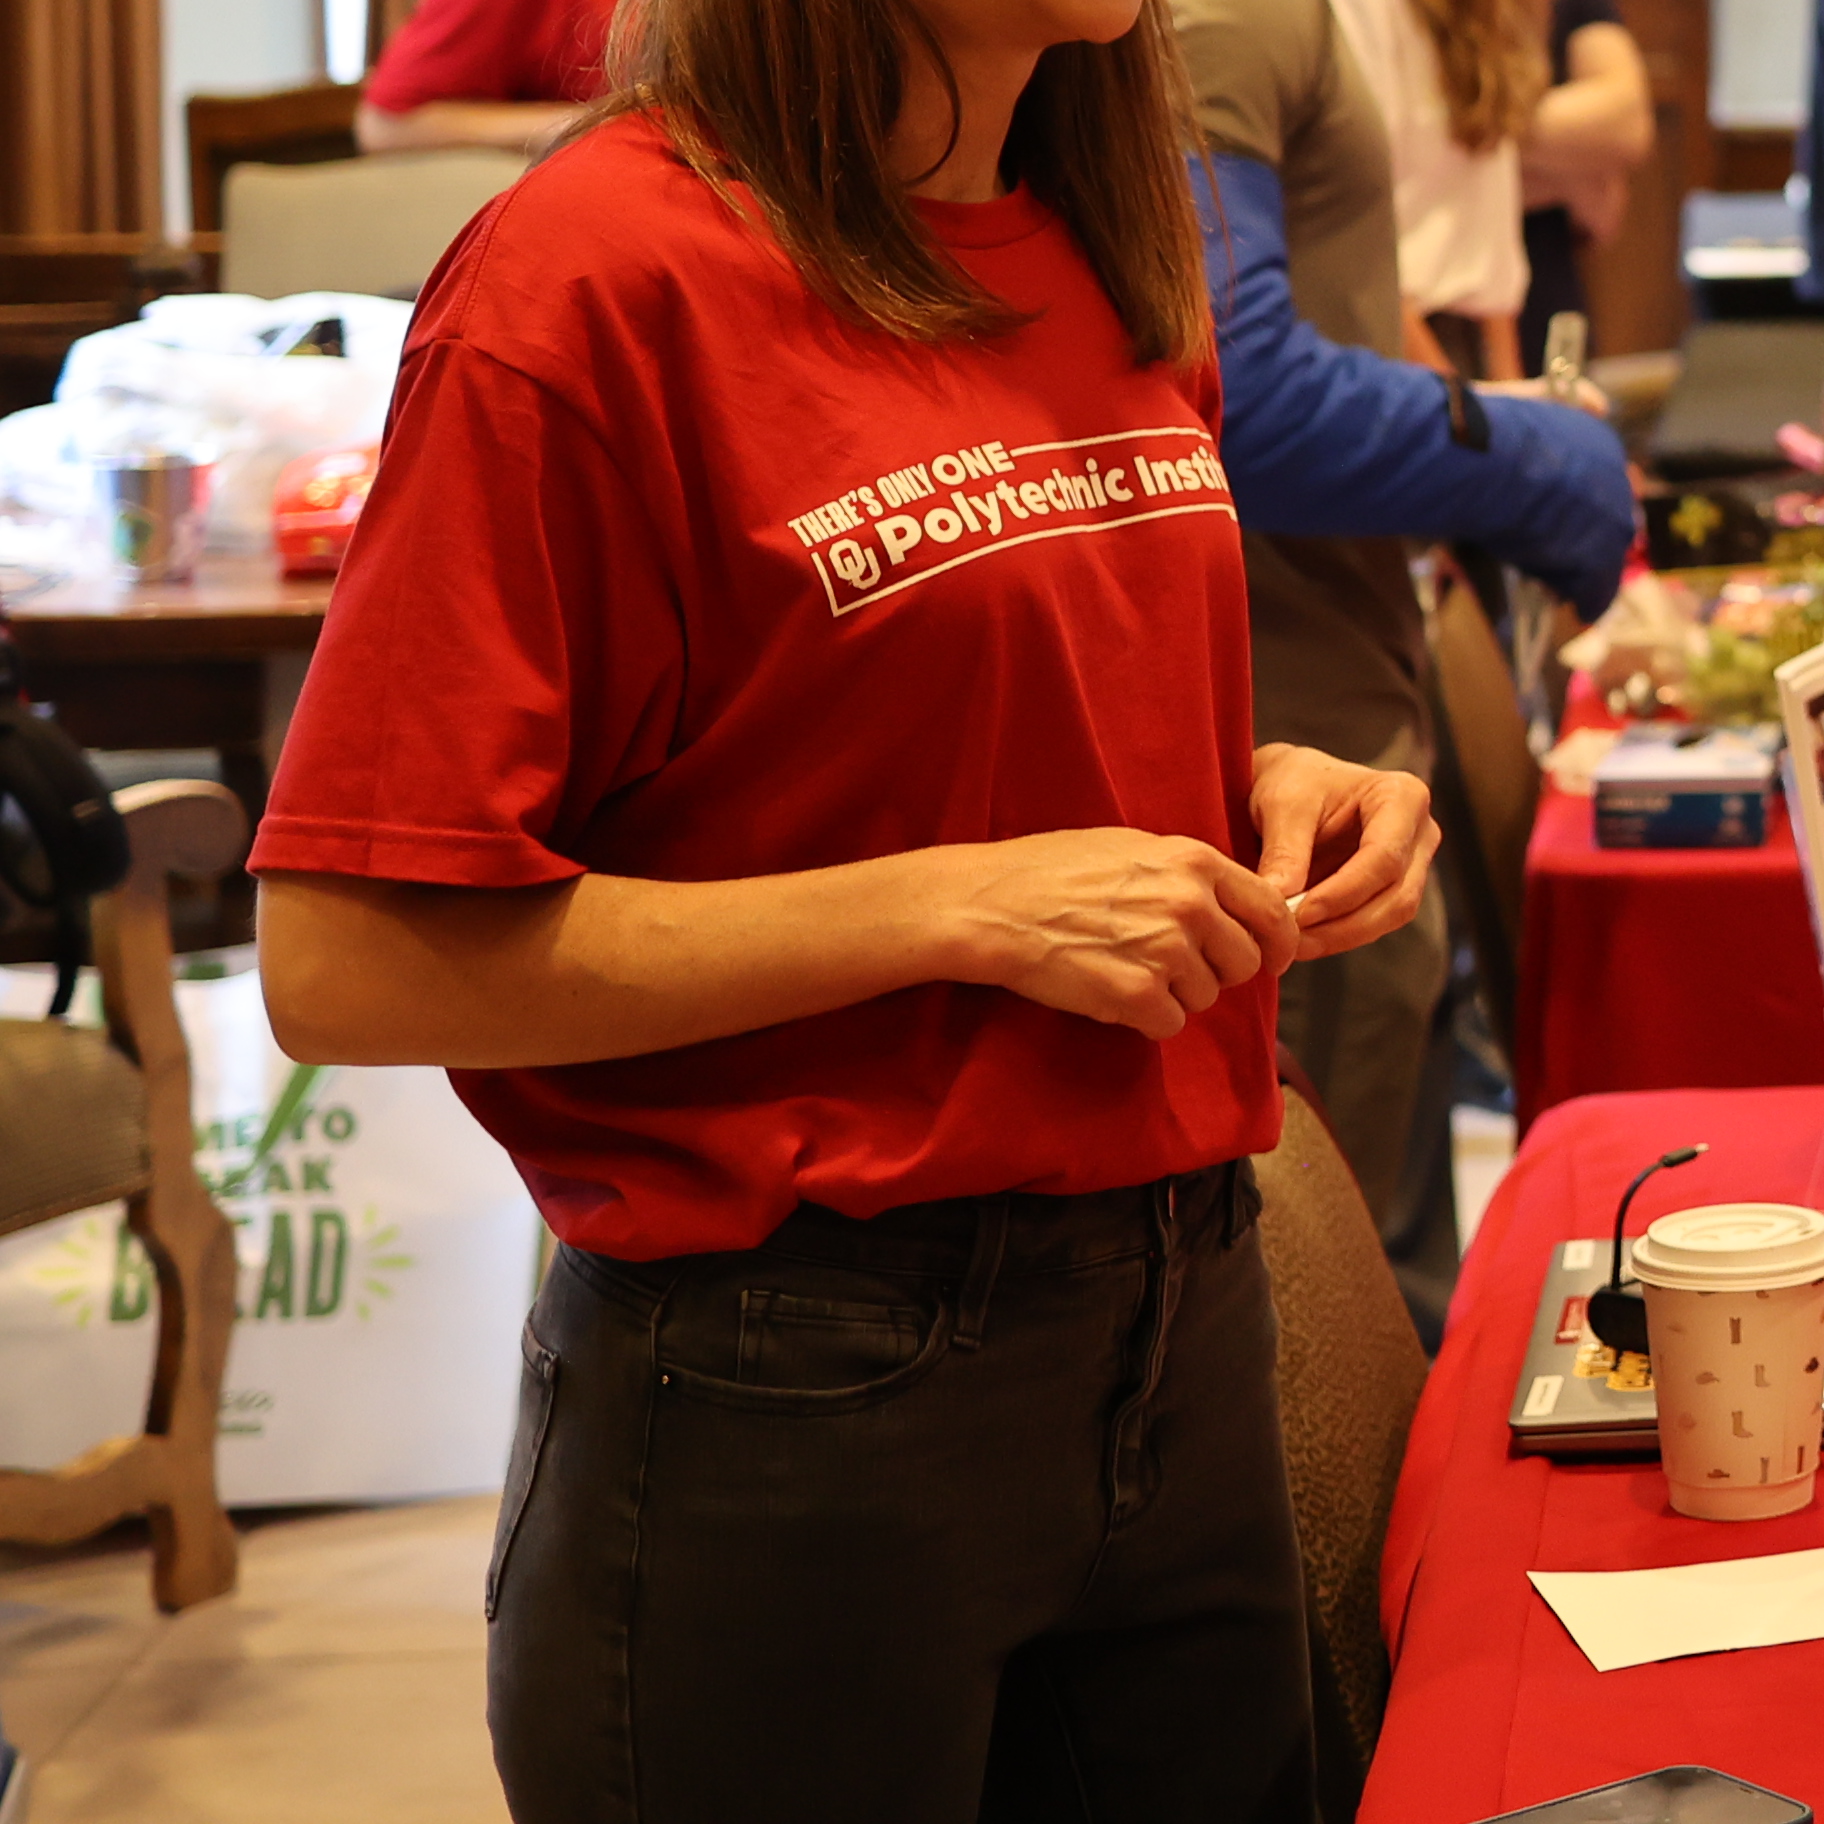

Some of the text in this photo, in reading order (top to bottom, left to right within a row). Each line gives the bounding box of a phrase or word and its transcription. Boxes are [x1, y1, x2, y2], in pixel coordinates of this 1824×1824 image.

[788, 440, 1016, 547] THERE'S ONLY ONE
[874, 457, 1134, 566] Polytechnic
